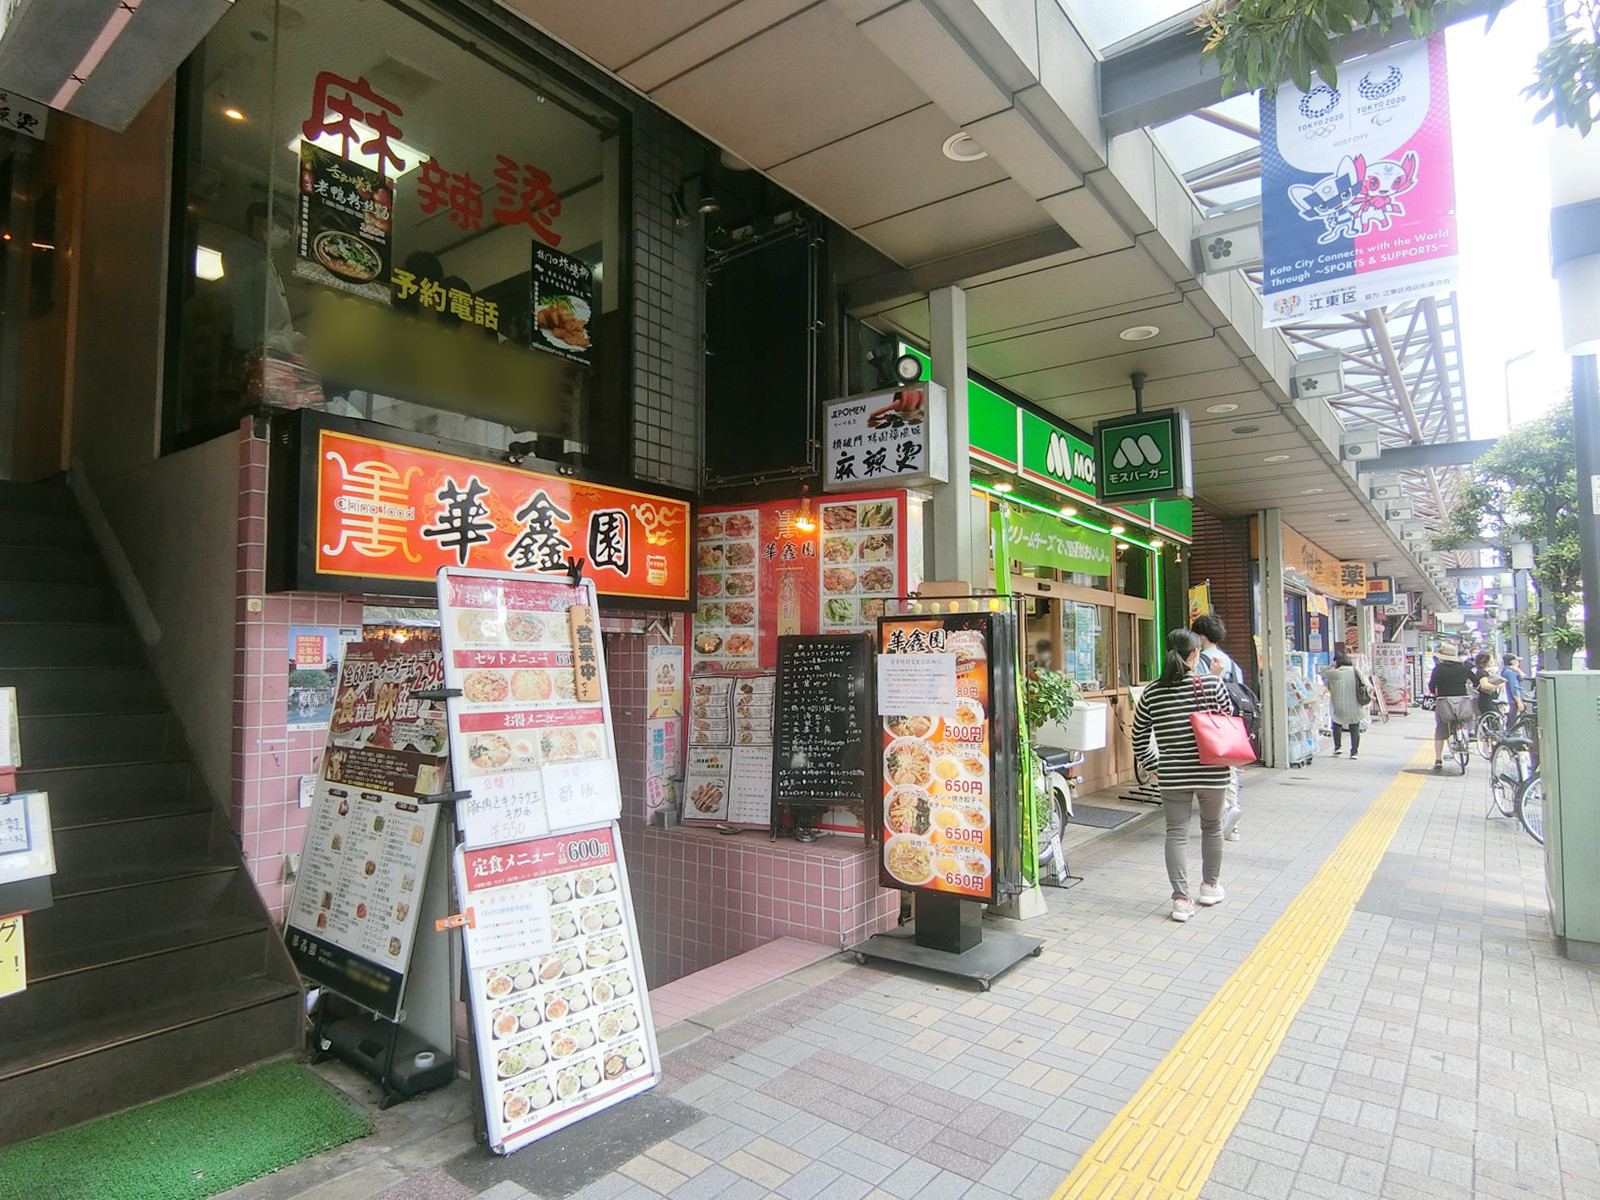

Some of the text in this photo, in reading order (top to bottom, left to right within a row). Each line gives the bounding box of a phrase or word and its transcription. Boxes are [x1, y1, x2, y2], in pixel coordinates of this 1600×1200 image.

[1357, 100, 1384, 114] TOKYO
[1385, 95, 1407, 107] 2020
[1297, 113, 1344, 132] TOKYO 2020
[1353, 132, 1369, 143] CITY
[1269, 228, 1450, 277] Koto City Connects with the World
[1270, 270, 1311, 287] Through
[1368, 255, 1377, 266] &
[390, 267, 500, 331] 予約電話
[1308, 290, 1357, 312] 江東区
[1073, 451, 1096, 485] MO
[1108, 467, 1169, 484] モスバーガー
[335, 496, 416, 520] China food
[422, 476, 632, 577] 華鑫園
[762, 540, 817, 561] 華鑫園
[1340, 564, 1364, 588] 薬
[887, 627, 947, 653] 華鑫園
[474, 651, 549, 665] セットメニュー
[503, 712, 565, 727] お得メニュー
[944, 725, 983, 742] 500円
[944, 778, 983, 795] 650円
[945, 826, 983, 844] 650円
[471, 848, 557, 879] 定食メニュー
[567, 837, 612, 863] 600円
[945, 872, 985, 890] 650円
